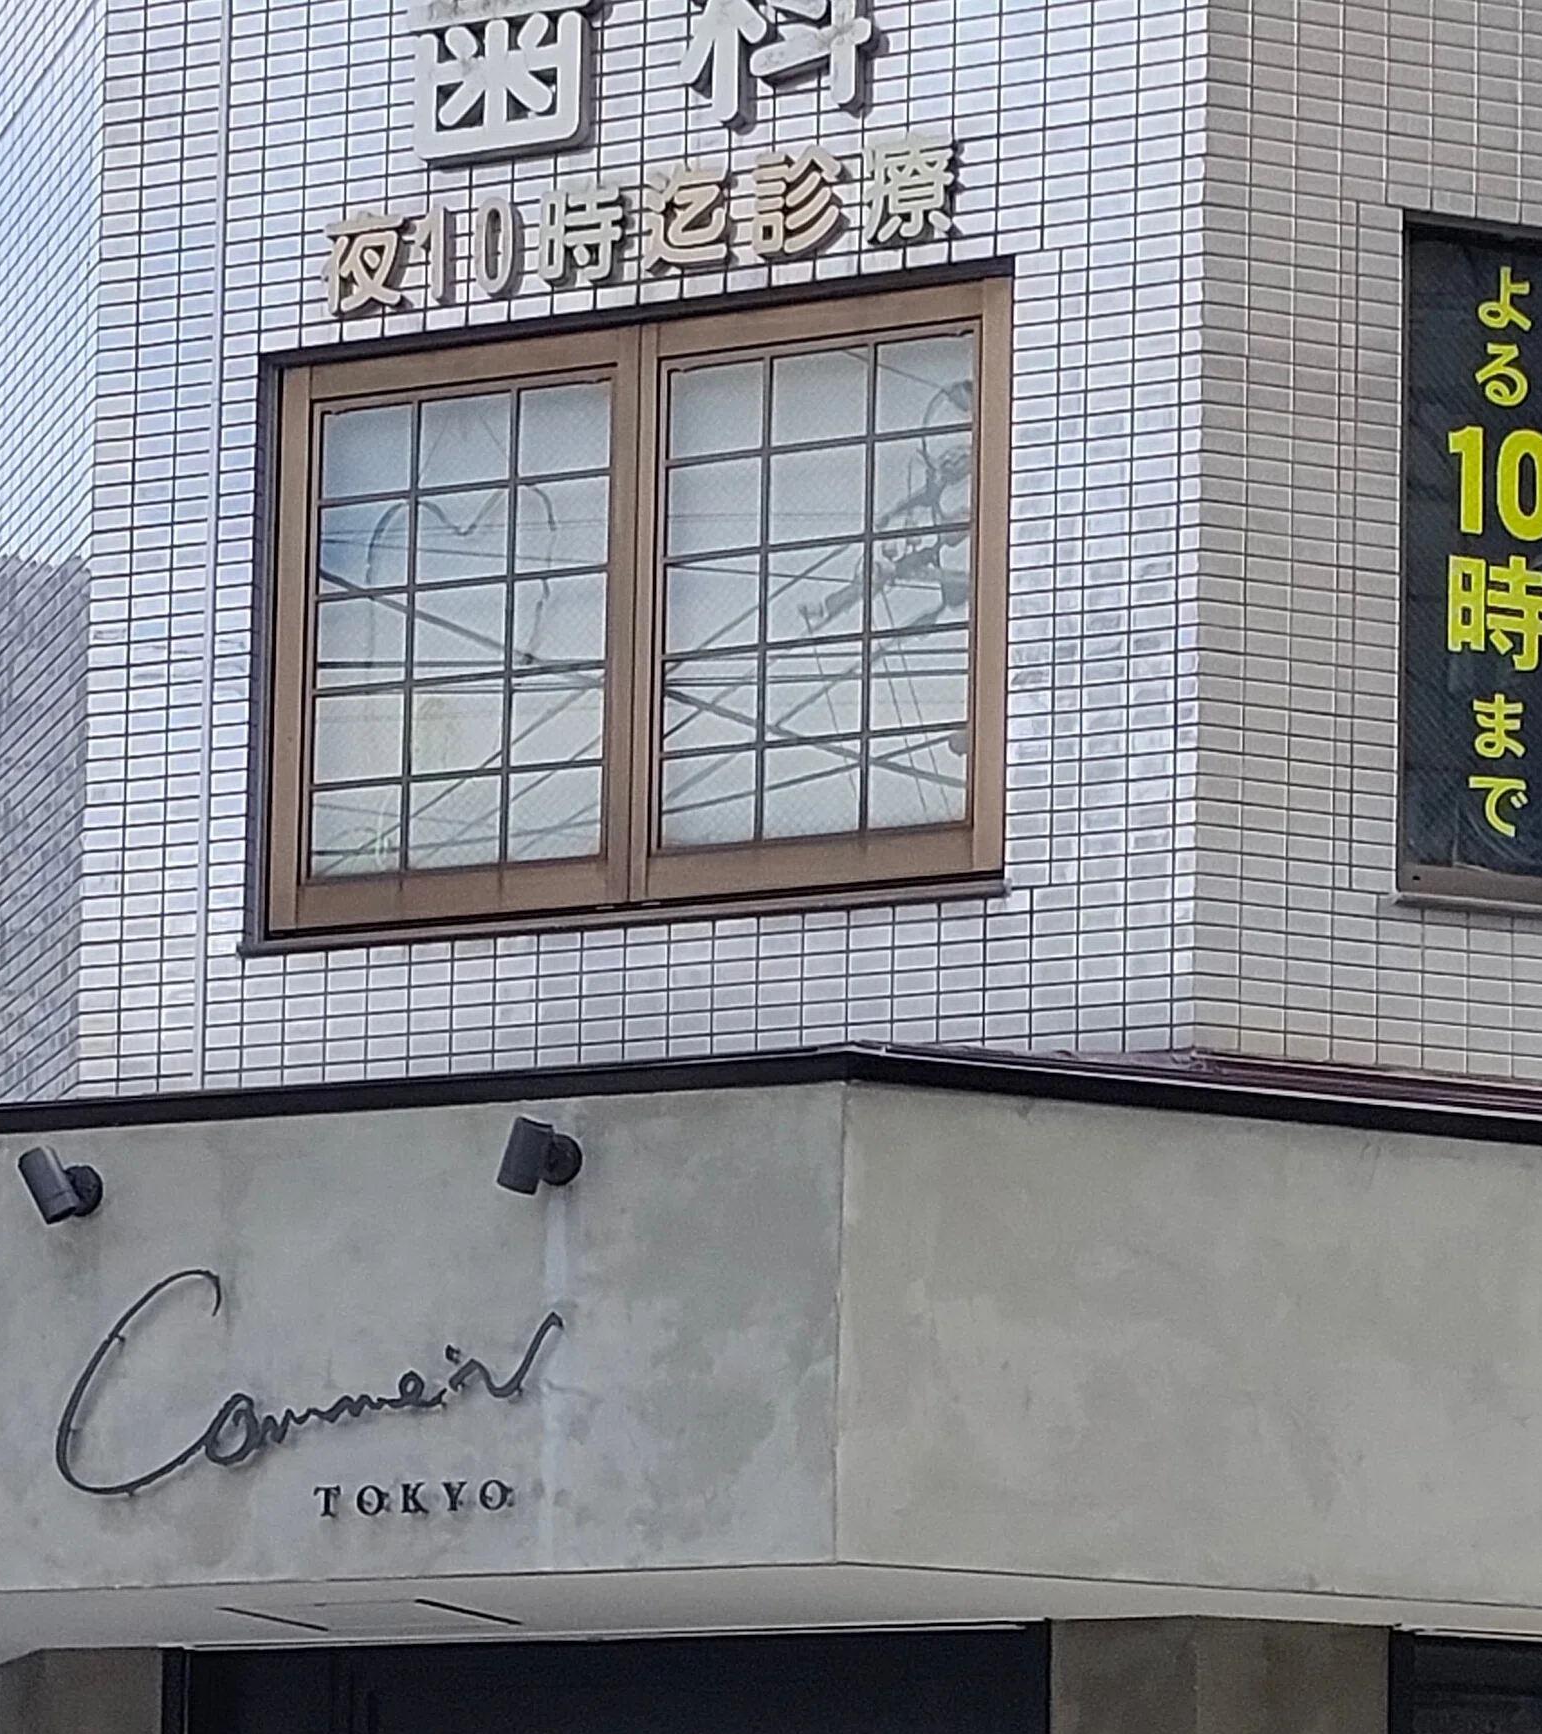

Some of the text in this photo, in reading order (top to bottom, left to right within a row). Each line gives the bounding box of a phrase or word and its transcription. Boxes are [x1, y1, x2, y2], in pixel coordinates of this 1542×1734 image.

[323, 134, 962, 316] 夜10時迄診療
[313, 1478, 515, 1518] TOKYO
